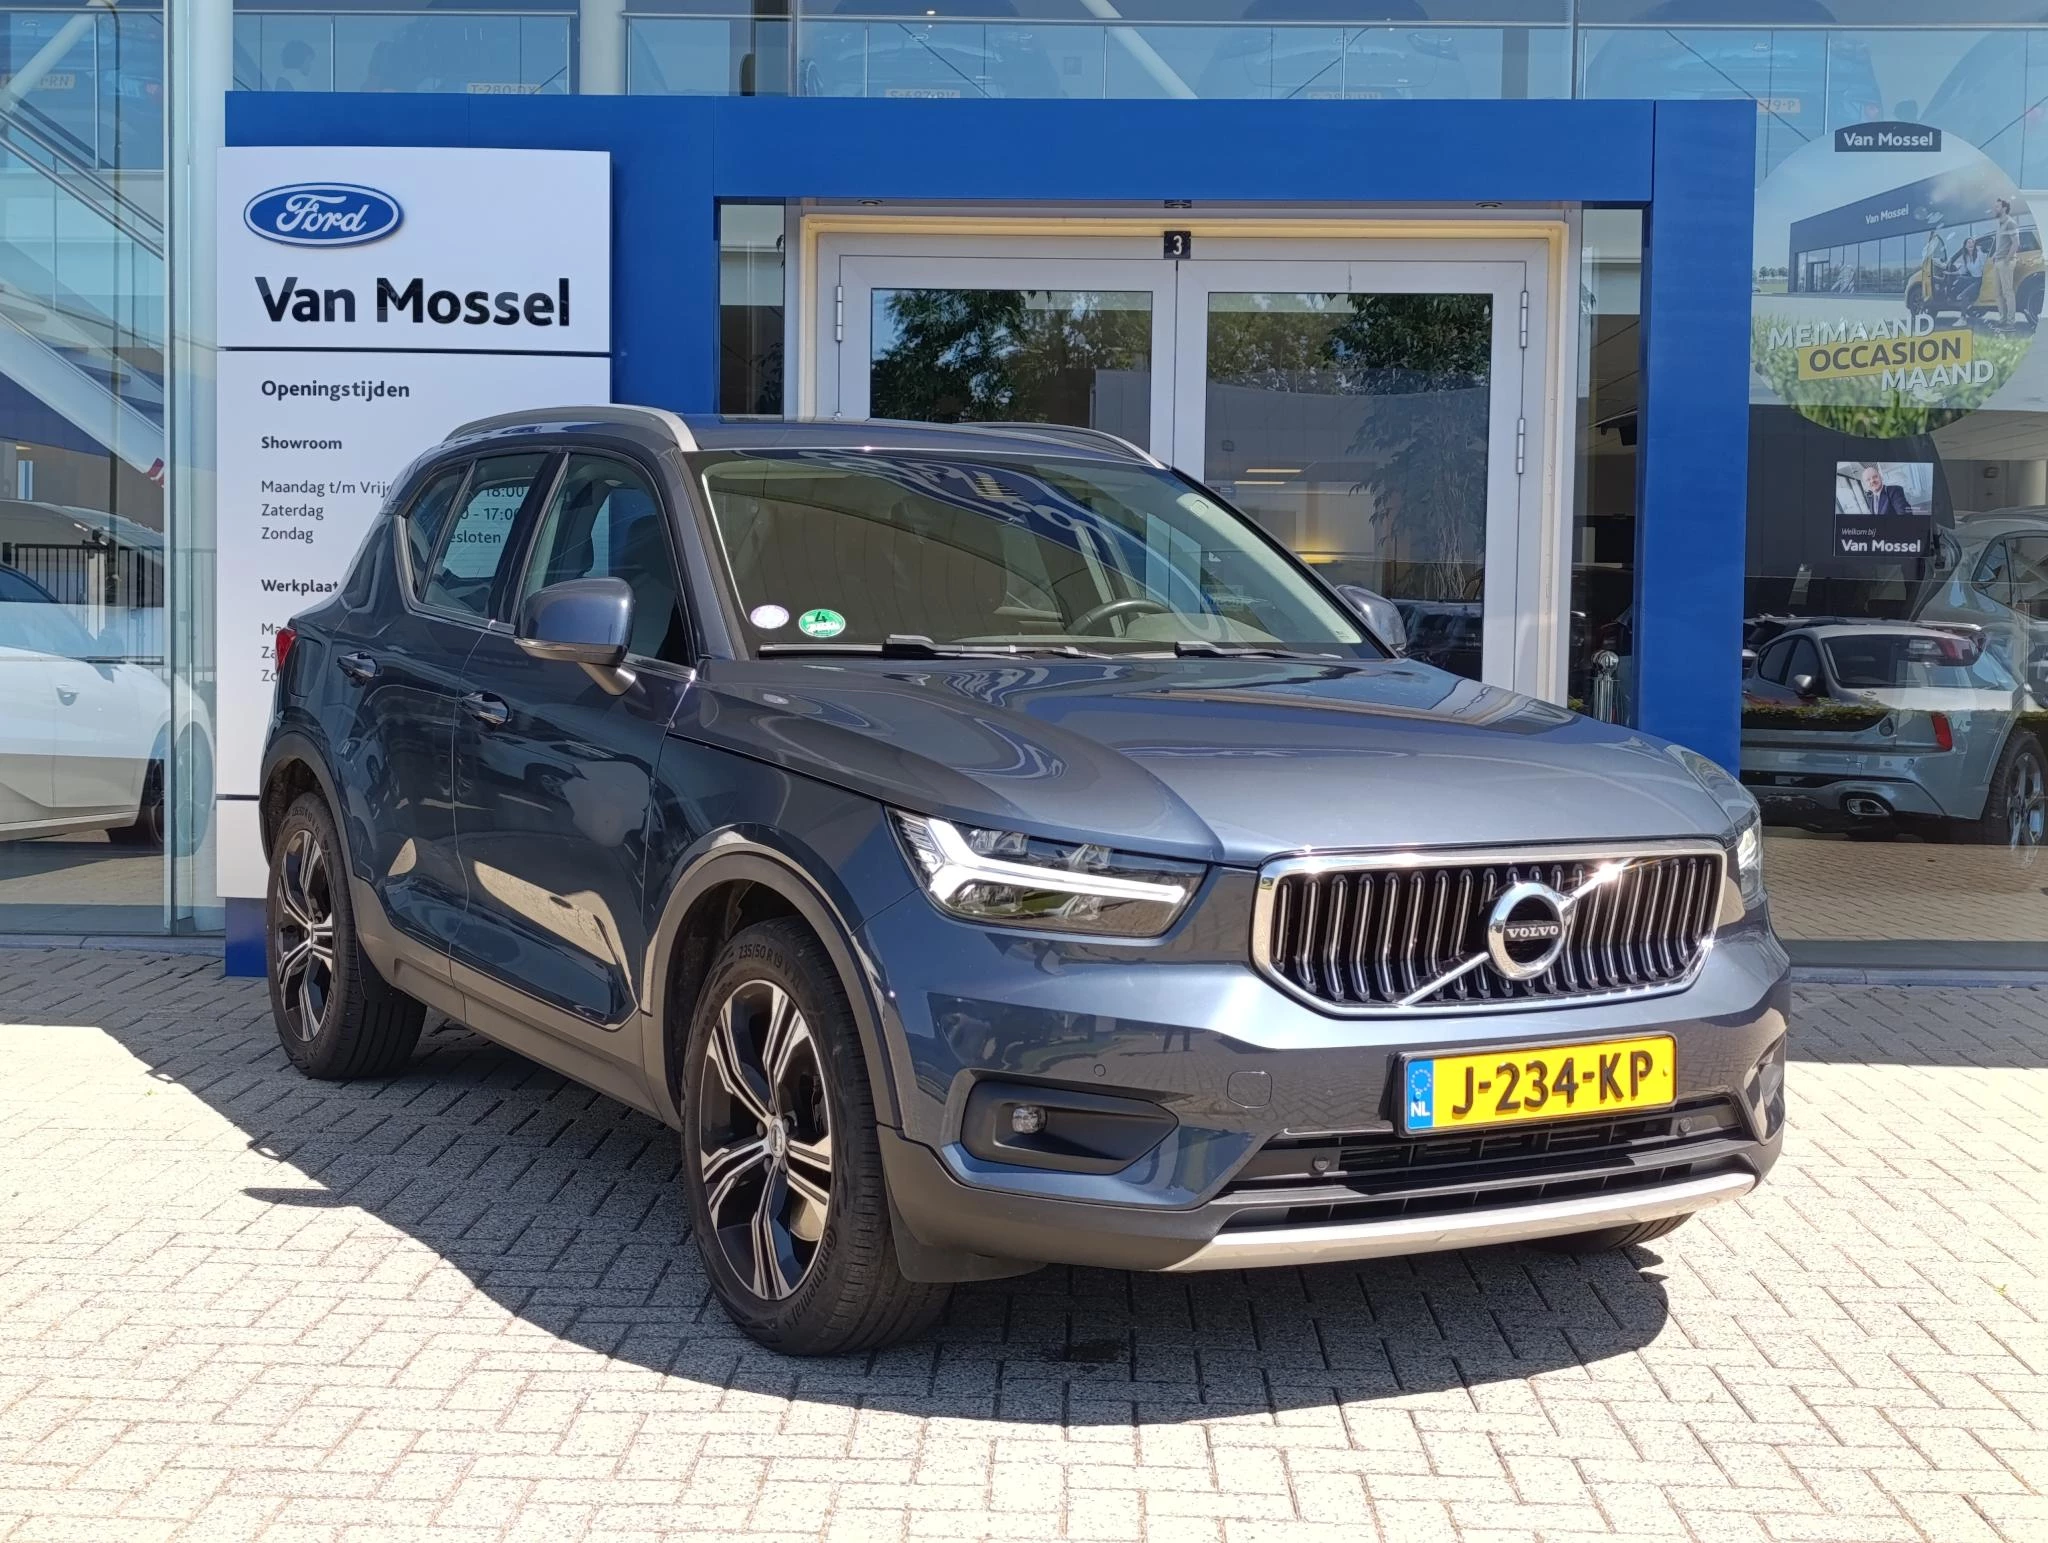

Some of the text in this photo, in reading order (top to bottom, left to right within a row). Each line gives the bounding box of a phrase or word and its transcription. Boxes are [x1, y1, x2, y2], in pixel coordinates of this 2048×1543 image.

[1843, 131, 1933, 147] Van Mossel
[275, 193, 372, 233] Ford
[1865, 203, 1909, 224] Van Mossel
[1172, 234, 1183, 256] 3
[254, 277, 570, 327] Van Mossel
[1767, 313, 1936, 350] MEIMAAND
[1808, 336, 1961, 372] OCCASION
[1881, 359, 1995, 392] MAAND
[261, 379, 410, 402] Openingstijden
[260, 435, 343, 450] Showroom
[261, 479, 326, 498] Maandag
[328, 480, 356, 495] t/m
[261, 503, 325, 521] Zaterdag
[261, 526, 314, 544] Zondag
[1841, 527, 1867, 536] Welkom
[1841, 539, 1921, 553] Van Mossel
[260, 578, 339, 597] Werkplaat
[814, 611, 828, 623] 4
[1506, 925, 1559, 939] VOLVO
[738, 943, 767, 960] 235/50
[1410, 1049, 1654, 1120] NL J-234-KP
